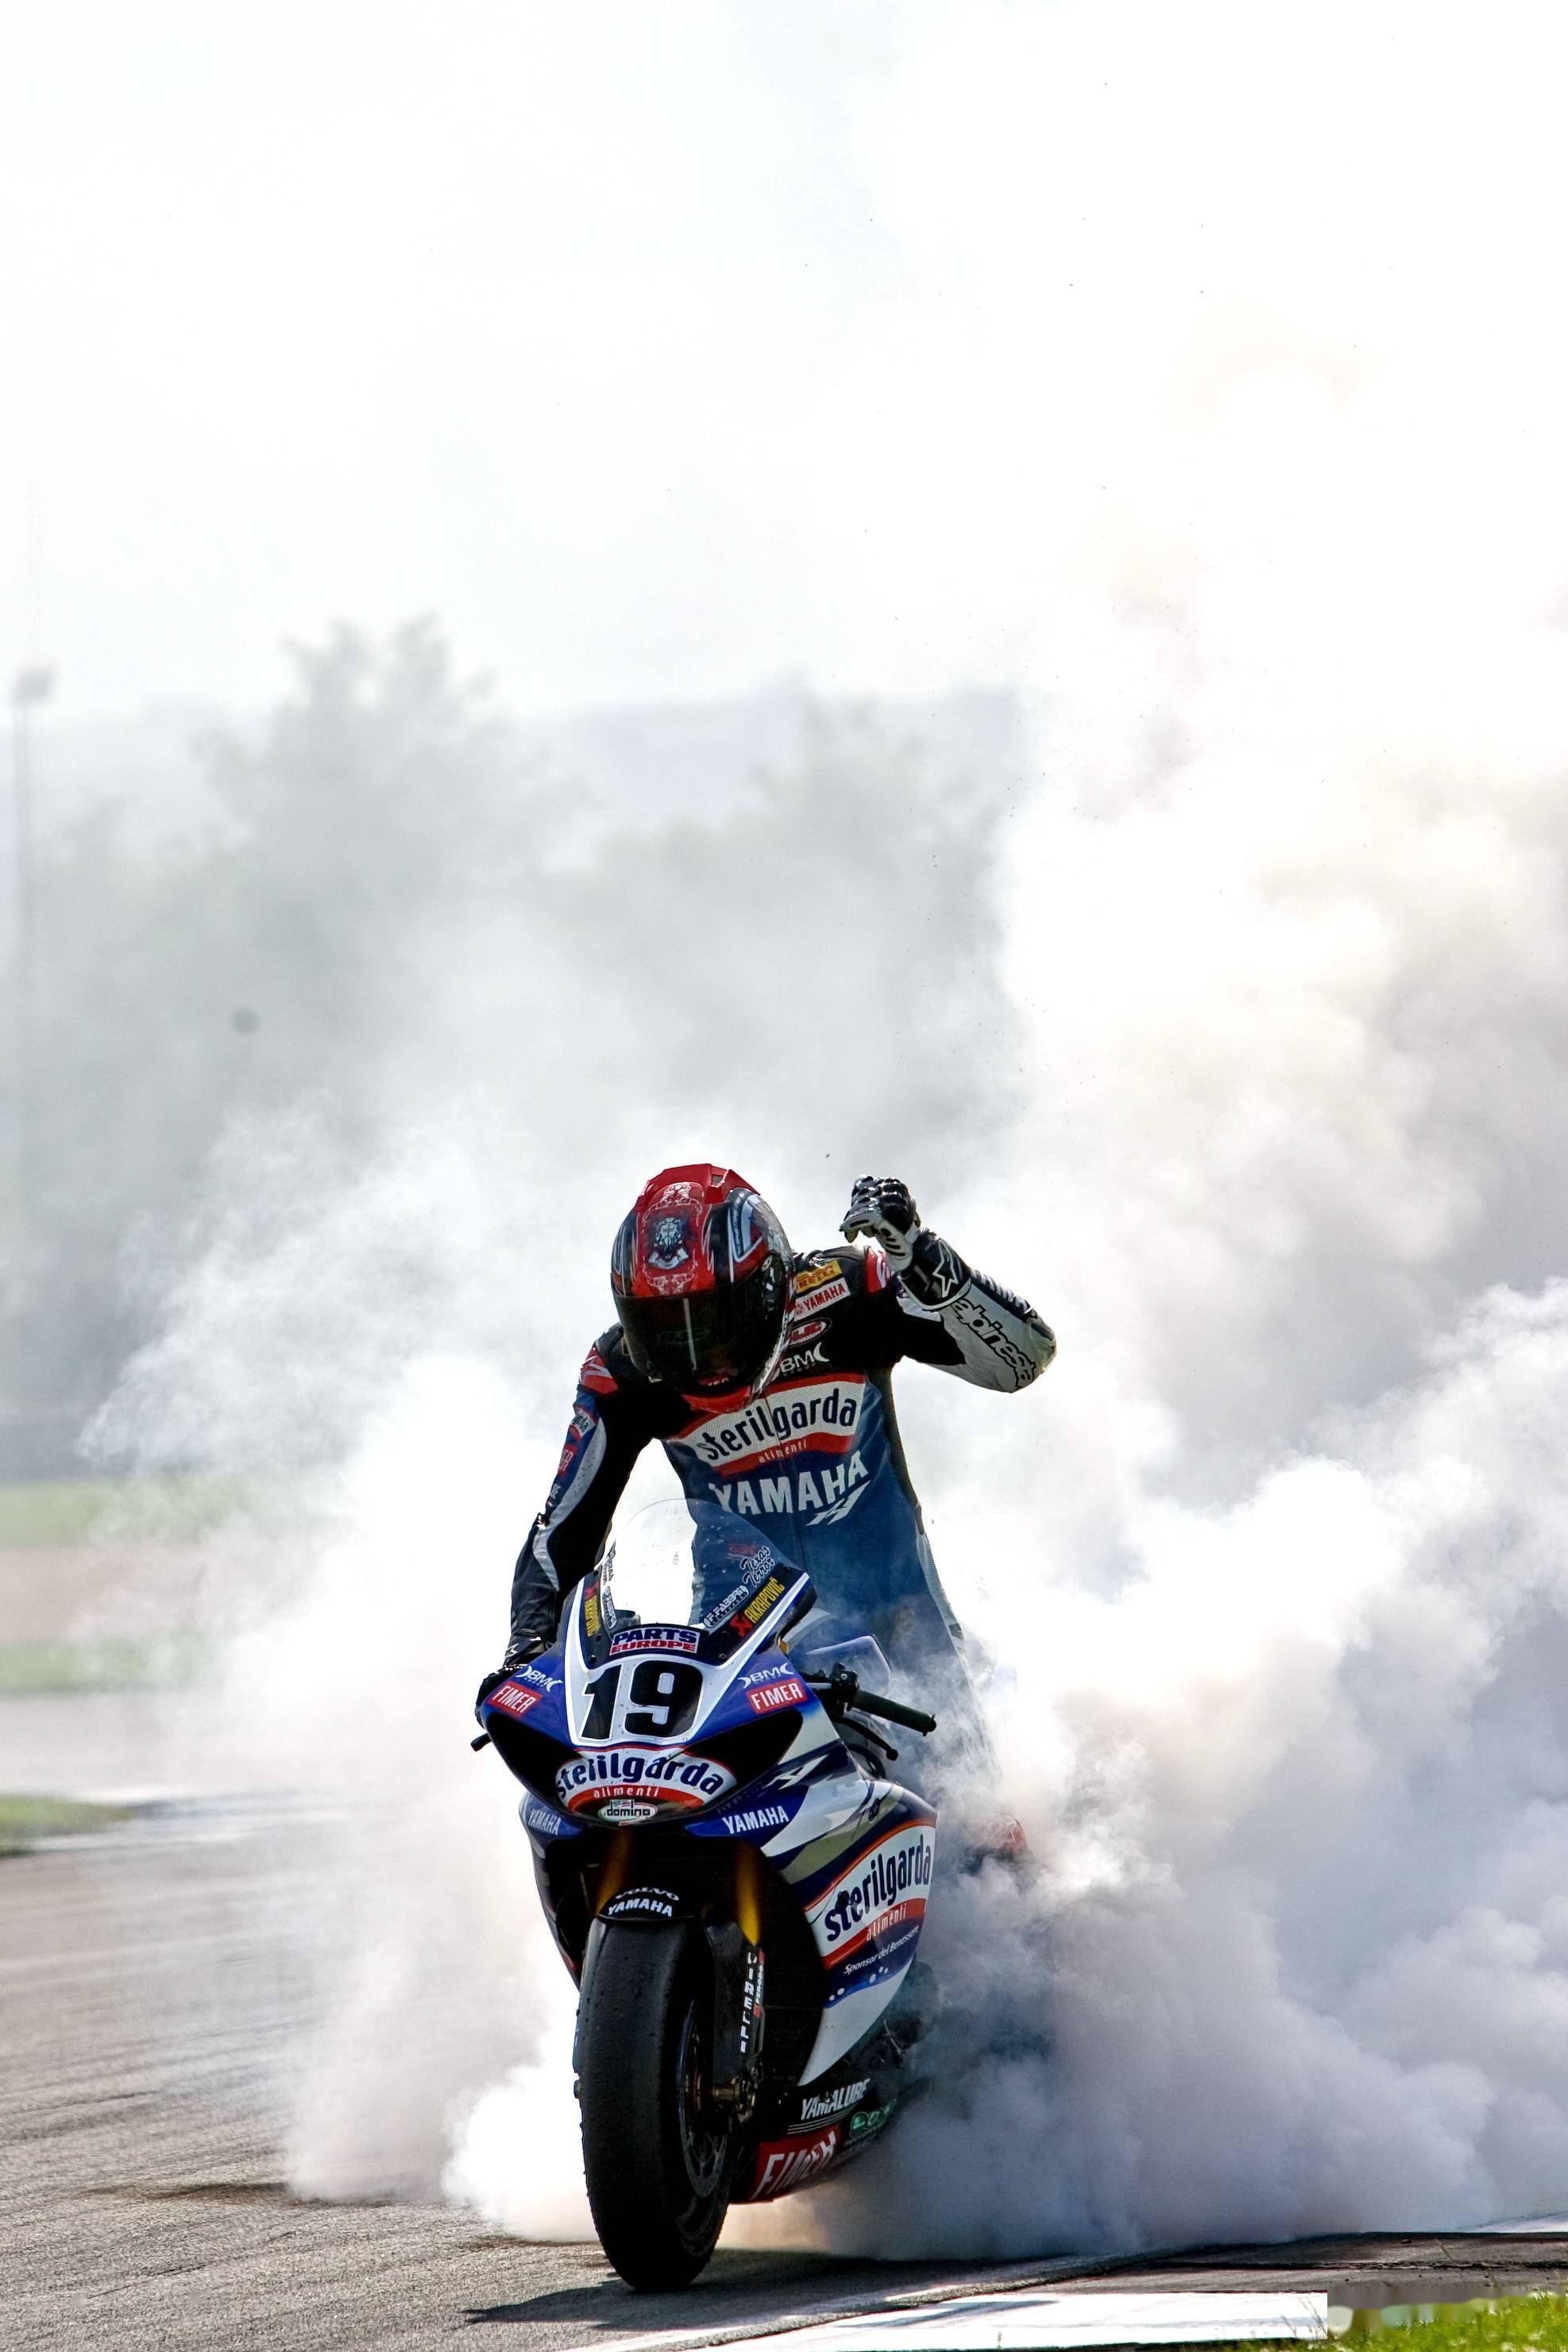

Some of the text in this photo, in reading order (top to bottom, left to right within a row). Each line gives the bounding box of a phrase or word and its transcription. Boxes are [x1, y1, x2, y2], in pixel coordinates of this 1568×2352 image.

[803, 1283, 845, 1311] YAMAHA
[696, 1388, 857, 1461] sterilgarda
[758, 1439, 808, 1463] alimenti
[709, 1450, 869, 1516] YAMAHA
[740, 1546, 771, 1576] Texas
[742, 1558, 776, 1588] Terror
[610, 1639, 697, 1654] EUROPE
[613, 1628, 697, 1645] PARTS
[492, 1685, 537, 1713] FIMER
[581, 1660, 704, 1740] 19
[751, 1682, 803, 1710] FIMER
[557, 1752, 724, 1799] sterilgarda
[593, 1786, 660, 1799] alimenti
[528, 1808, 562, 1836] YAMAHA
[606, 1799, 651, 1817] domino
[722, 1805, 790, 1836] YAMAHA
[824, 1833, 932, 1943] sterilgarda
[608, 1898, 673, 1918] YAMAHA
[866, 1903, 907, 1942] alimenti
[844, 1954, 879, 1975] Sponsor
